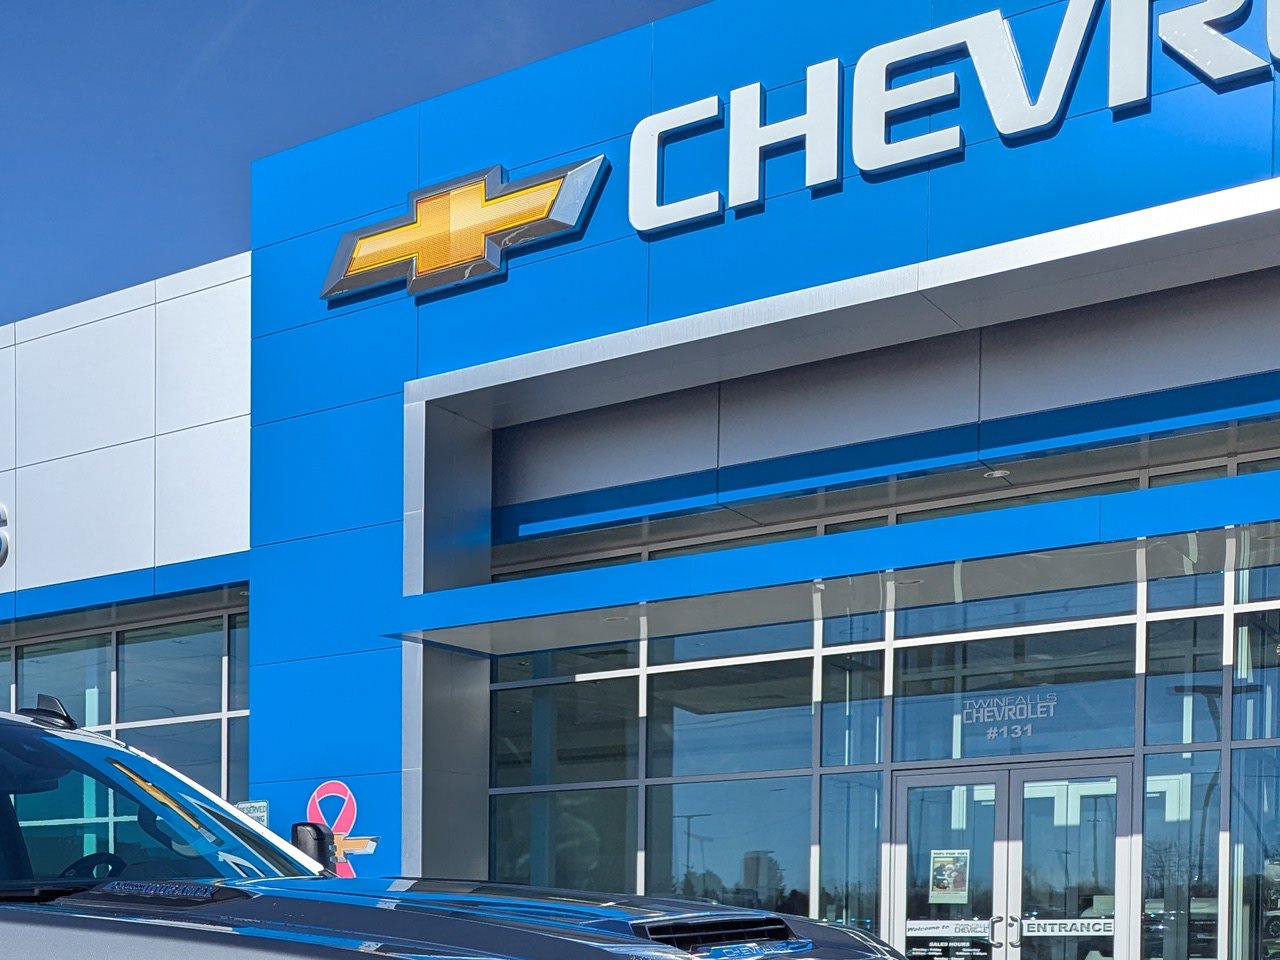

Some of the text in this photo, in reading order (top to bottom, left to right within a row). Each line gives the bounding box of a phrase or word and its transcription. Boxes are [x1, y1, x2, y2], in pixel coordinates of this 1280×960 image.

[628, 0, 1280, 235] CHEVR
[963, 702, 1057, 723] CHEVROLET
[986, 724, 1033, 739] #131
[1026, 922, 1113, 932] ENTRANCE
